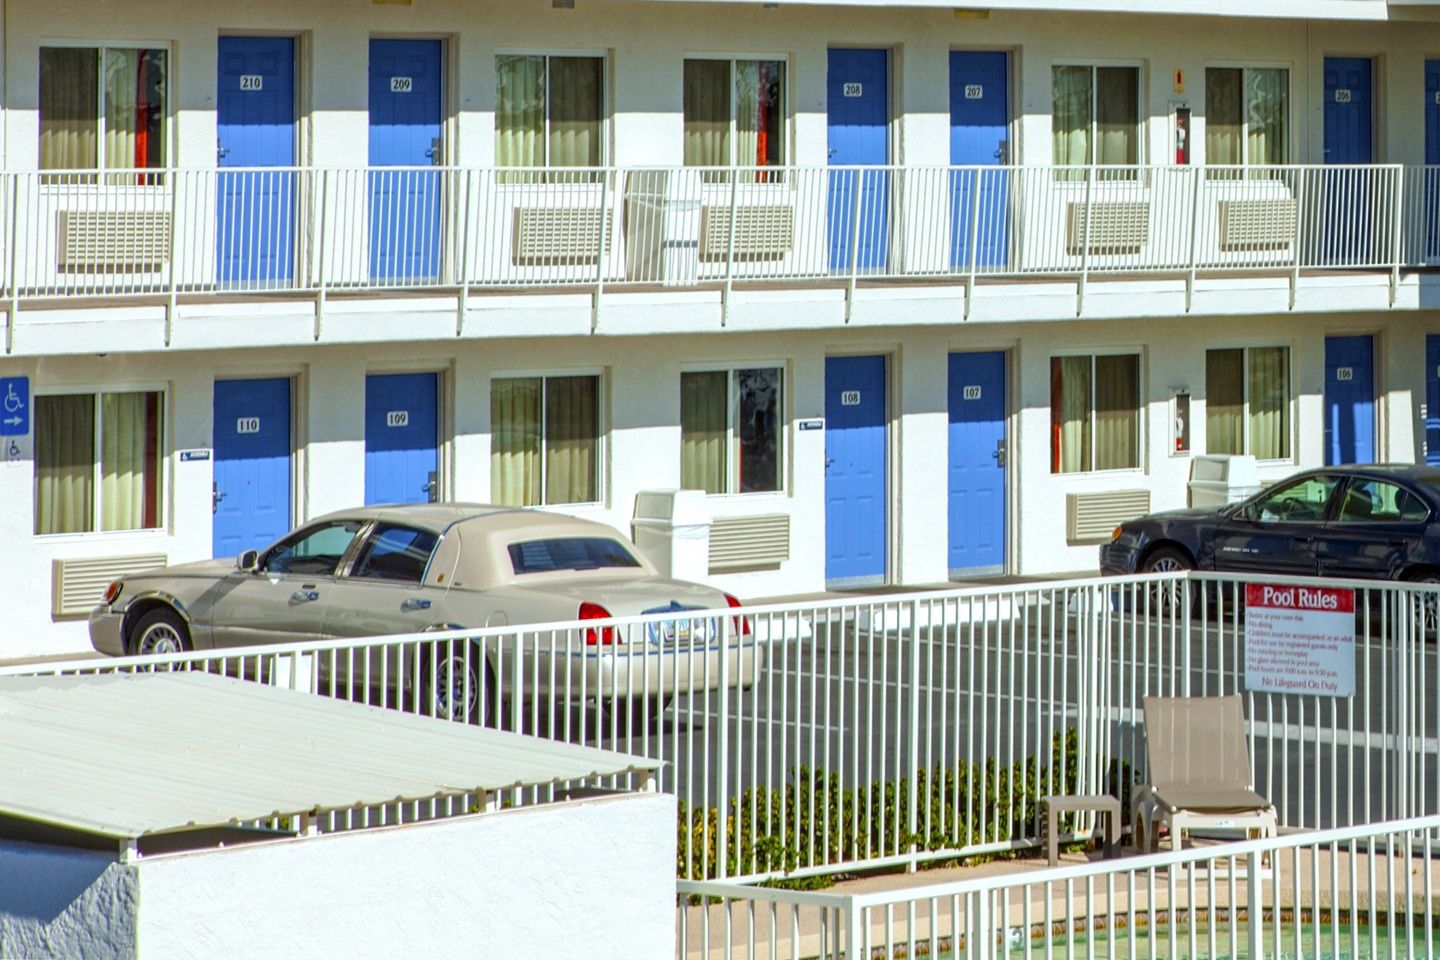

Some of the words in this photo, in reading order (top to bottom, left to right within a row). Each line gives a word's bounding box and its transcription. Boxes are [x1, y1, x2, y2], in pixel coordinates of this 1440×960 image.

[242, 77, 260, 88] 210
[393, 79, 410, 90] 209
[845, 85, 861, 95] 208
[967, 87, 981, 97] 207
[844, 393, 858, 403] 108
[965, 388, 979, 398] 107
[390, 413, 406, 424] 109
[239, 420, 257, 431] 110
[1263, 587, 1295, 607] Pool
[1298, 588, 1338, 609] Rules
[1262, 677, 1273, 686] No
[1275, 677, 1306, 690] Lifeguard
[1308, 680, 1319, 689] On
